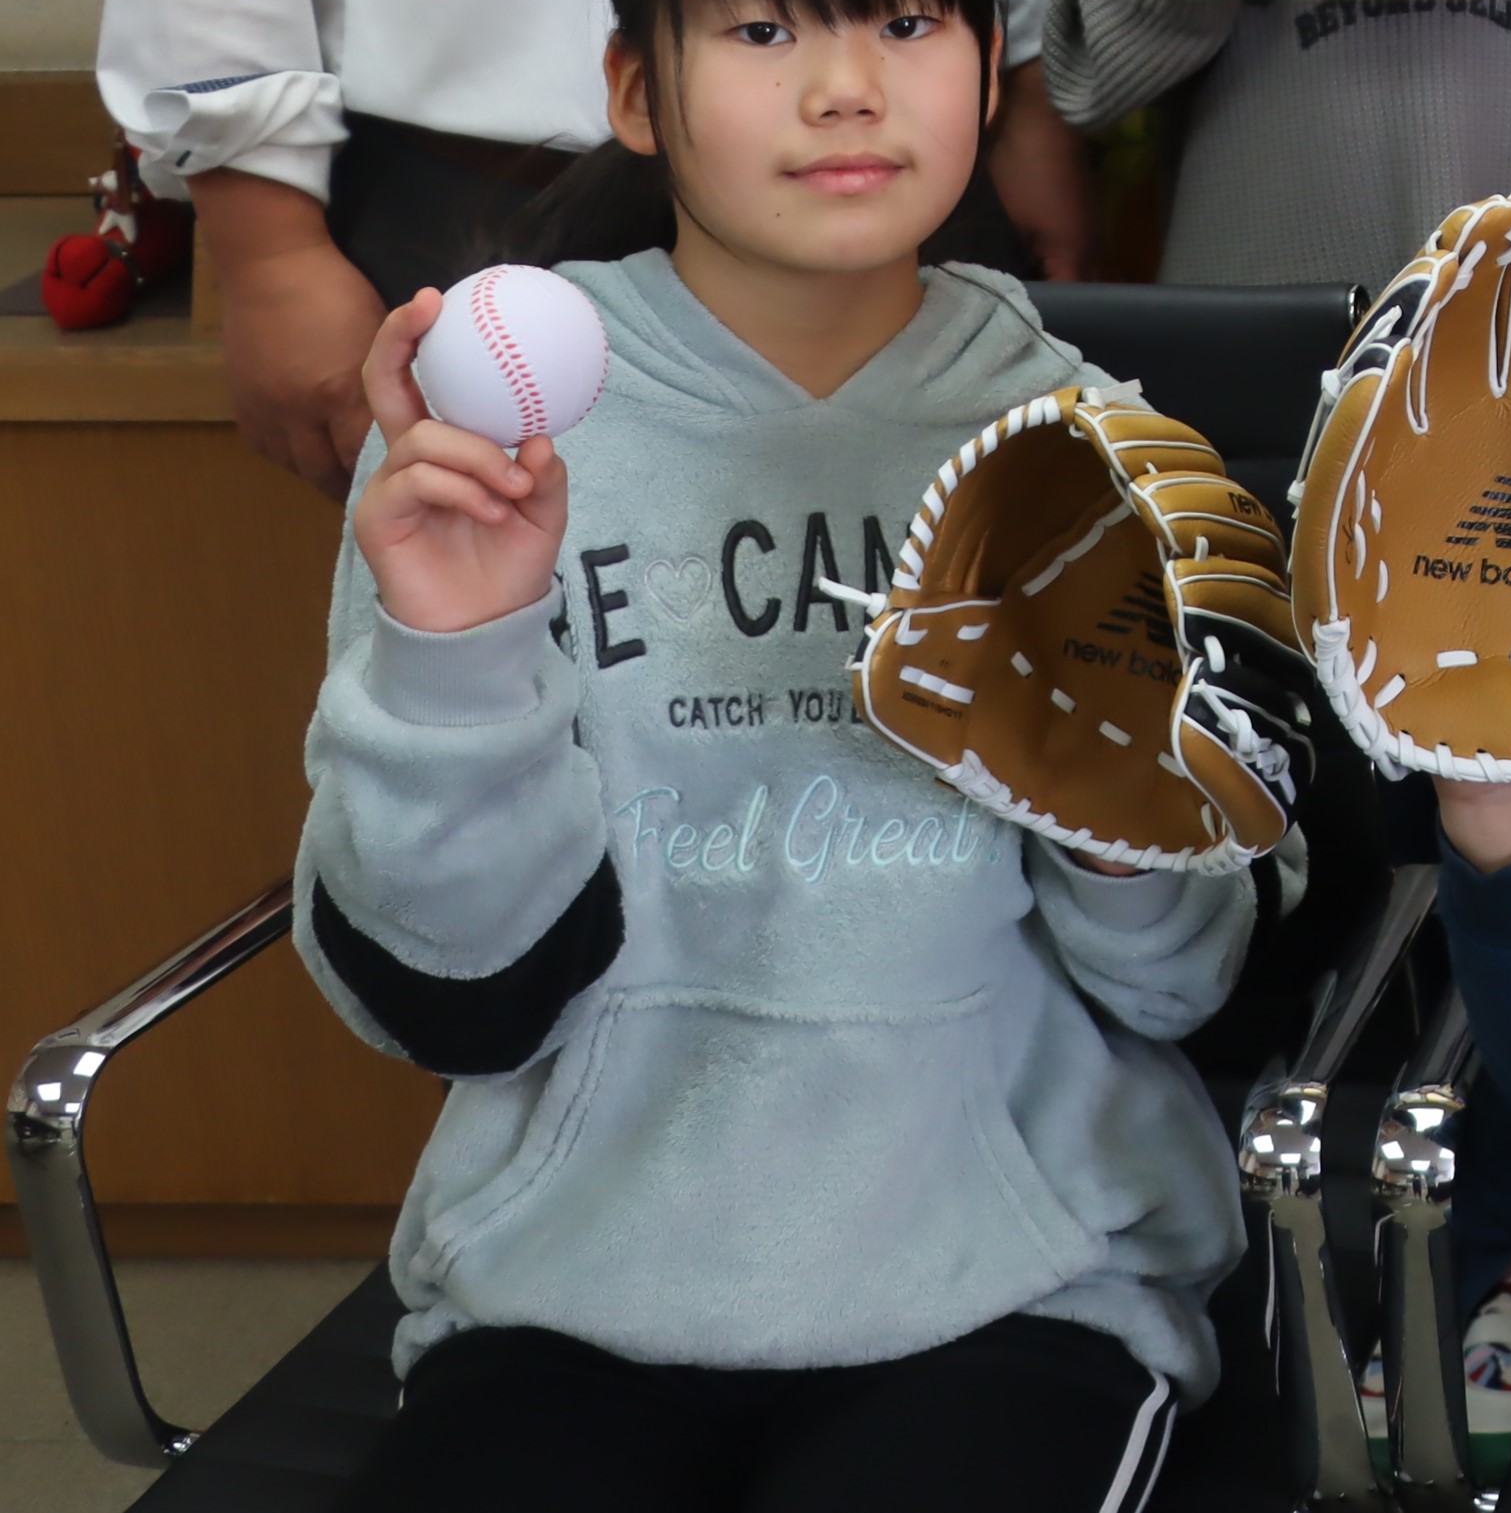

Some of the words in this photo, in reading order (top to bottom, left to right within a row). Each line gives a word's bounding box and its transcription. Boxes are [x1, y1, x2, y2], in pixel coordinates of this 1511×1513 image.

[1412, 554, 1473, 583] new
[579, 543, 646, 669] E
[1063, 638, 1122, 667] new
[668, 693, 765, 729] CATCH
[614, 785, 769, 874] Feel
